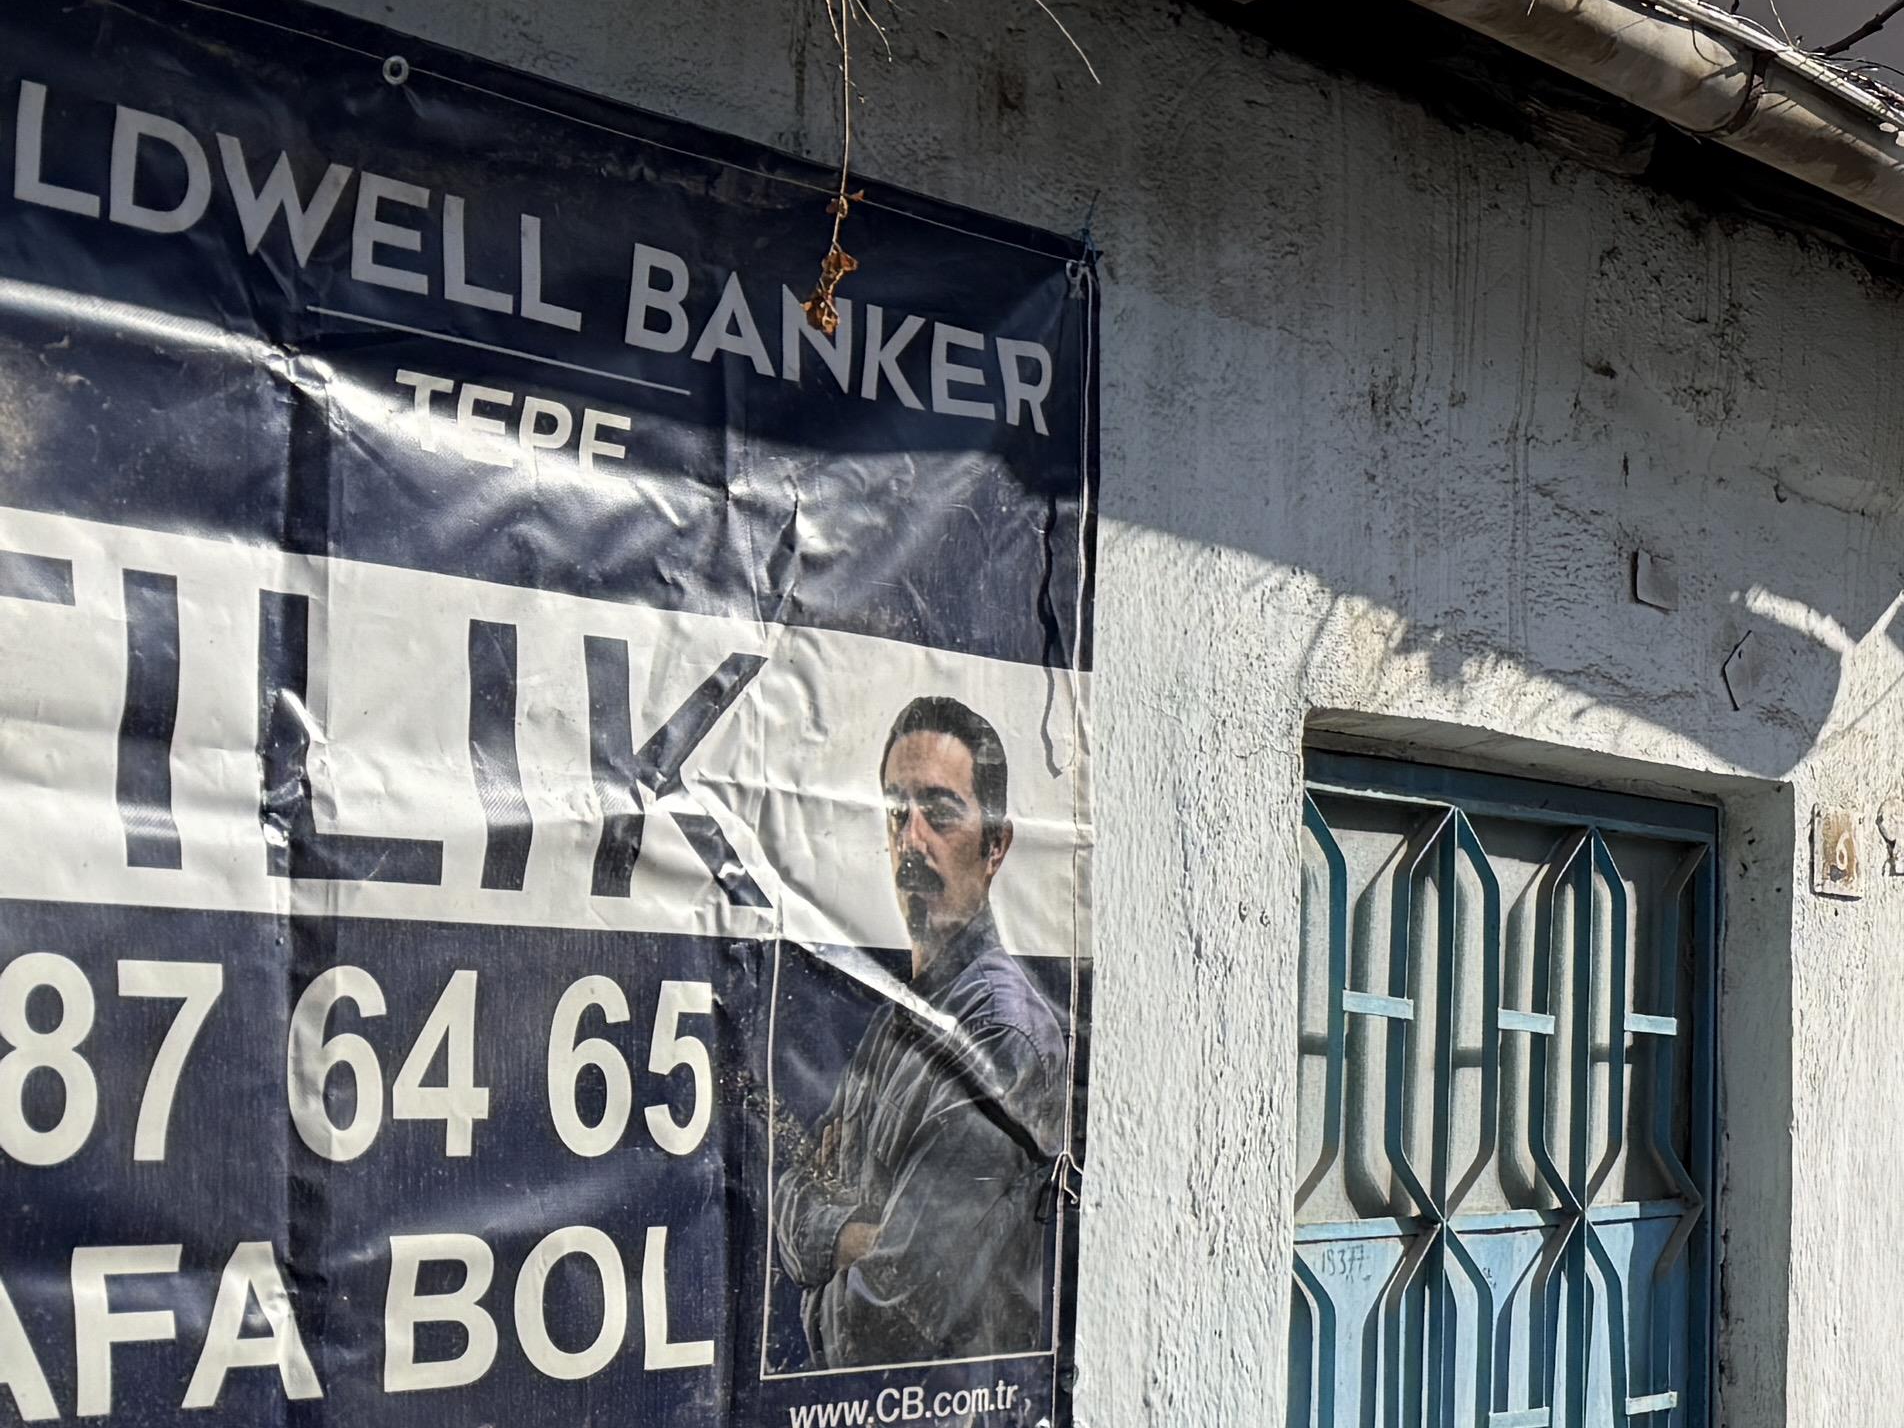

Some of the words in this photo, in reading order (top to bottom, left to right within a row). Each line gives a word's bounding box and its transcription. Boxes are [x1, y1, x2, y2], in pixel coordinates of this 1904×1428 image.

[13, 79, 583, 333] LDWELL
[624, 242, 1053, 436] BANKER
[395, 369, 632, 478] TEPE
[0, 952, 223, 1166] 87
[286, 965, 490, 1162] 64
[547, 974, 714, 1158] 65
[384, 1224, 715, 1393] BOL
